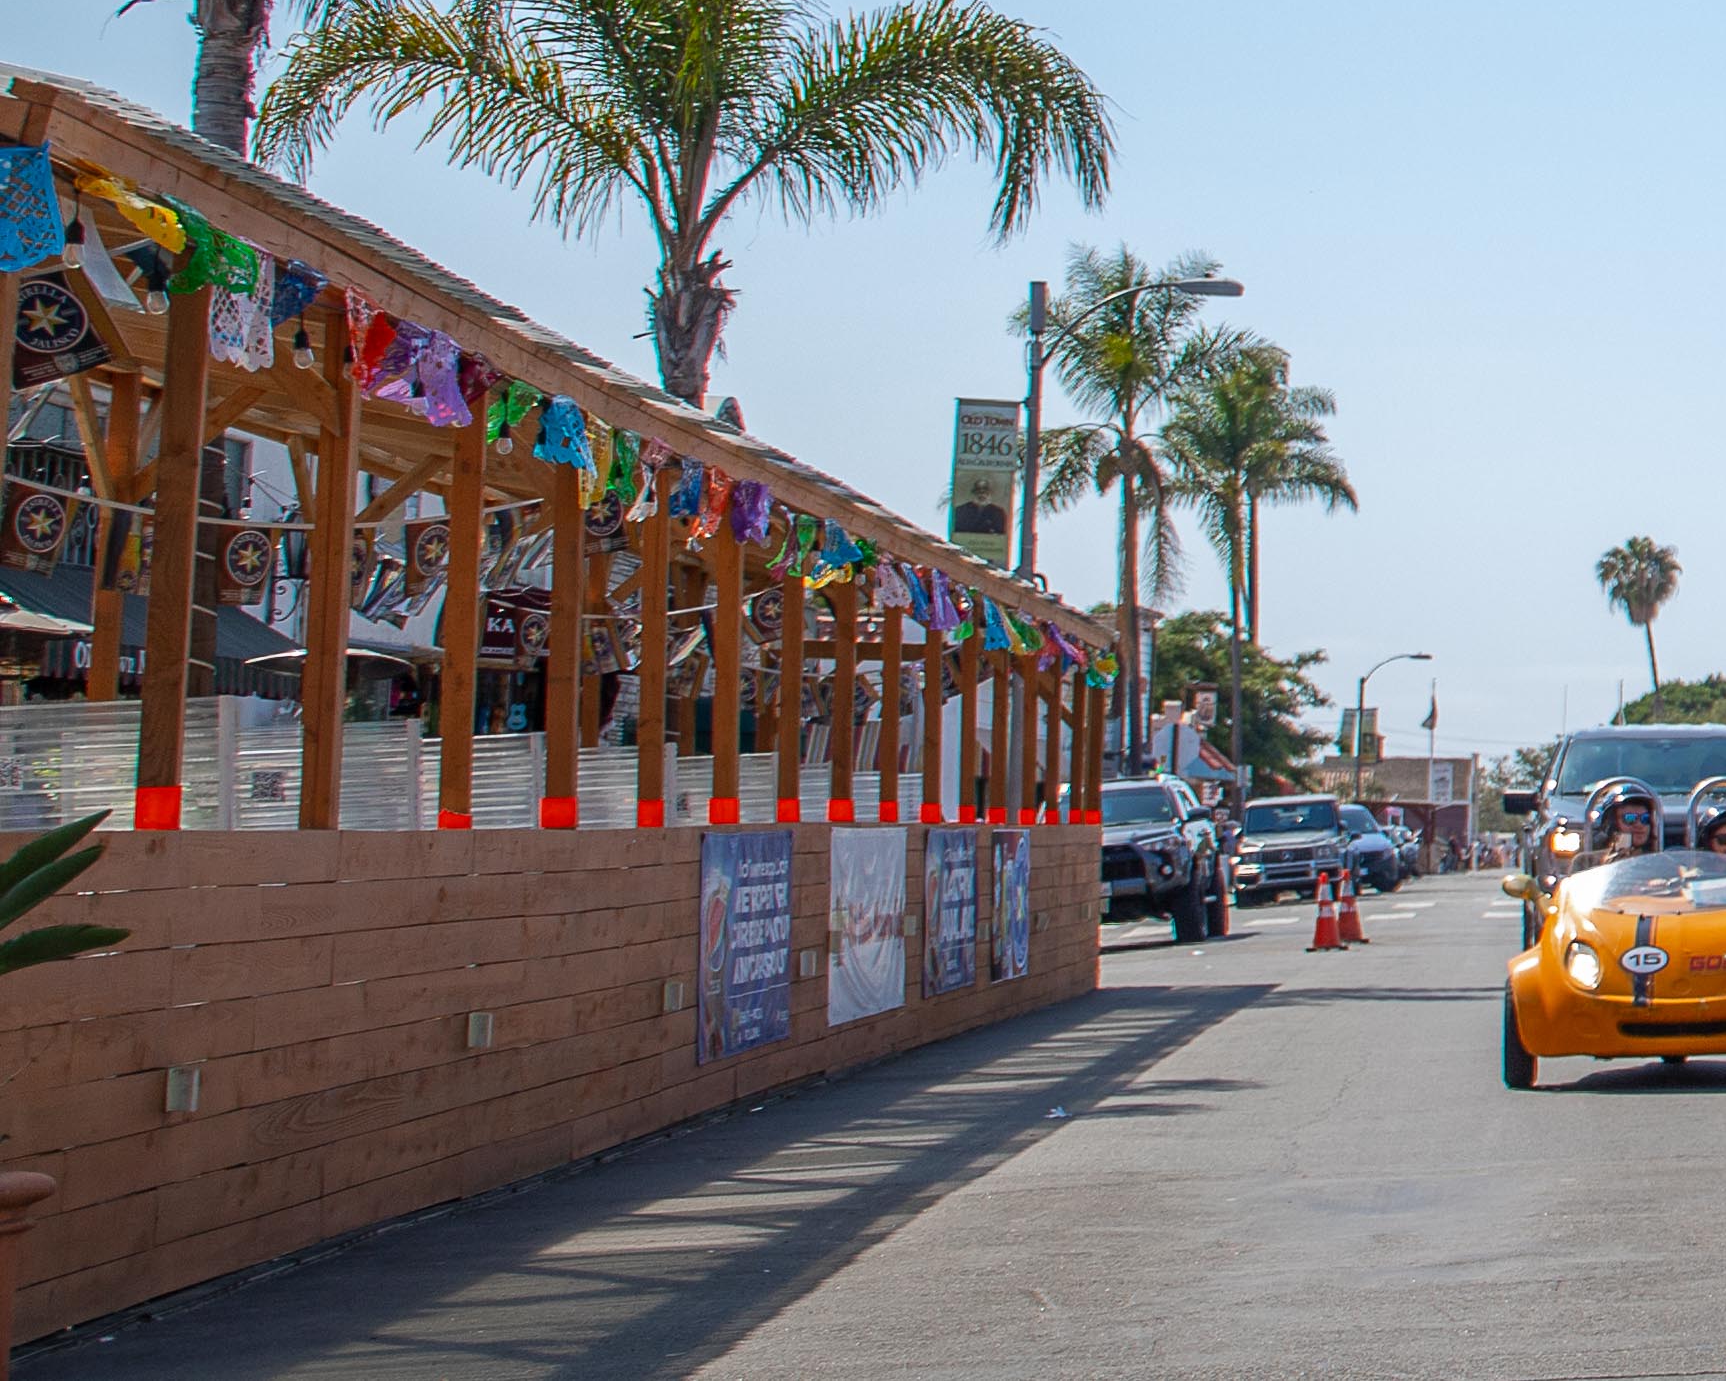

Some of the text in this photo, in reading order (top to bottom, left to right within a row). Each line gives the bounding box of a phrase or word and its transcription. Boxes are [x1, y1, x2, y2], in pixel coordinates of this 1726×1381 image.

[961, 415, 1014, 426] OLD TOWN
[961, 433, 1012, 456] 1846
[487, 617, 515, 633] KA
[1629, 952, 1661, 967] 15
